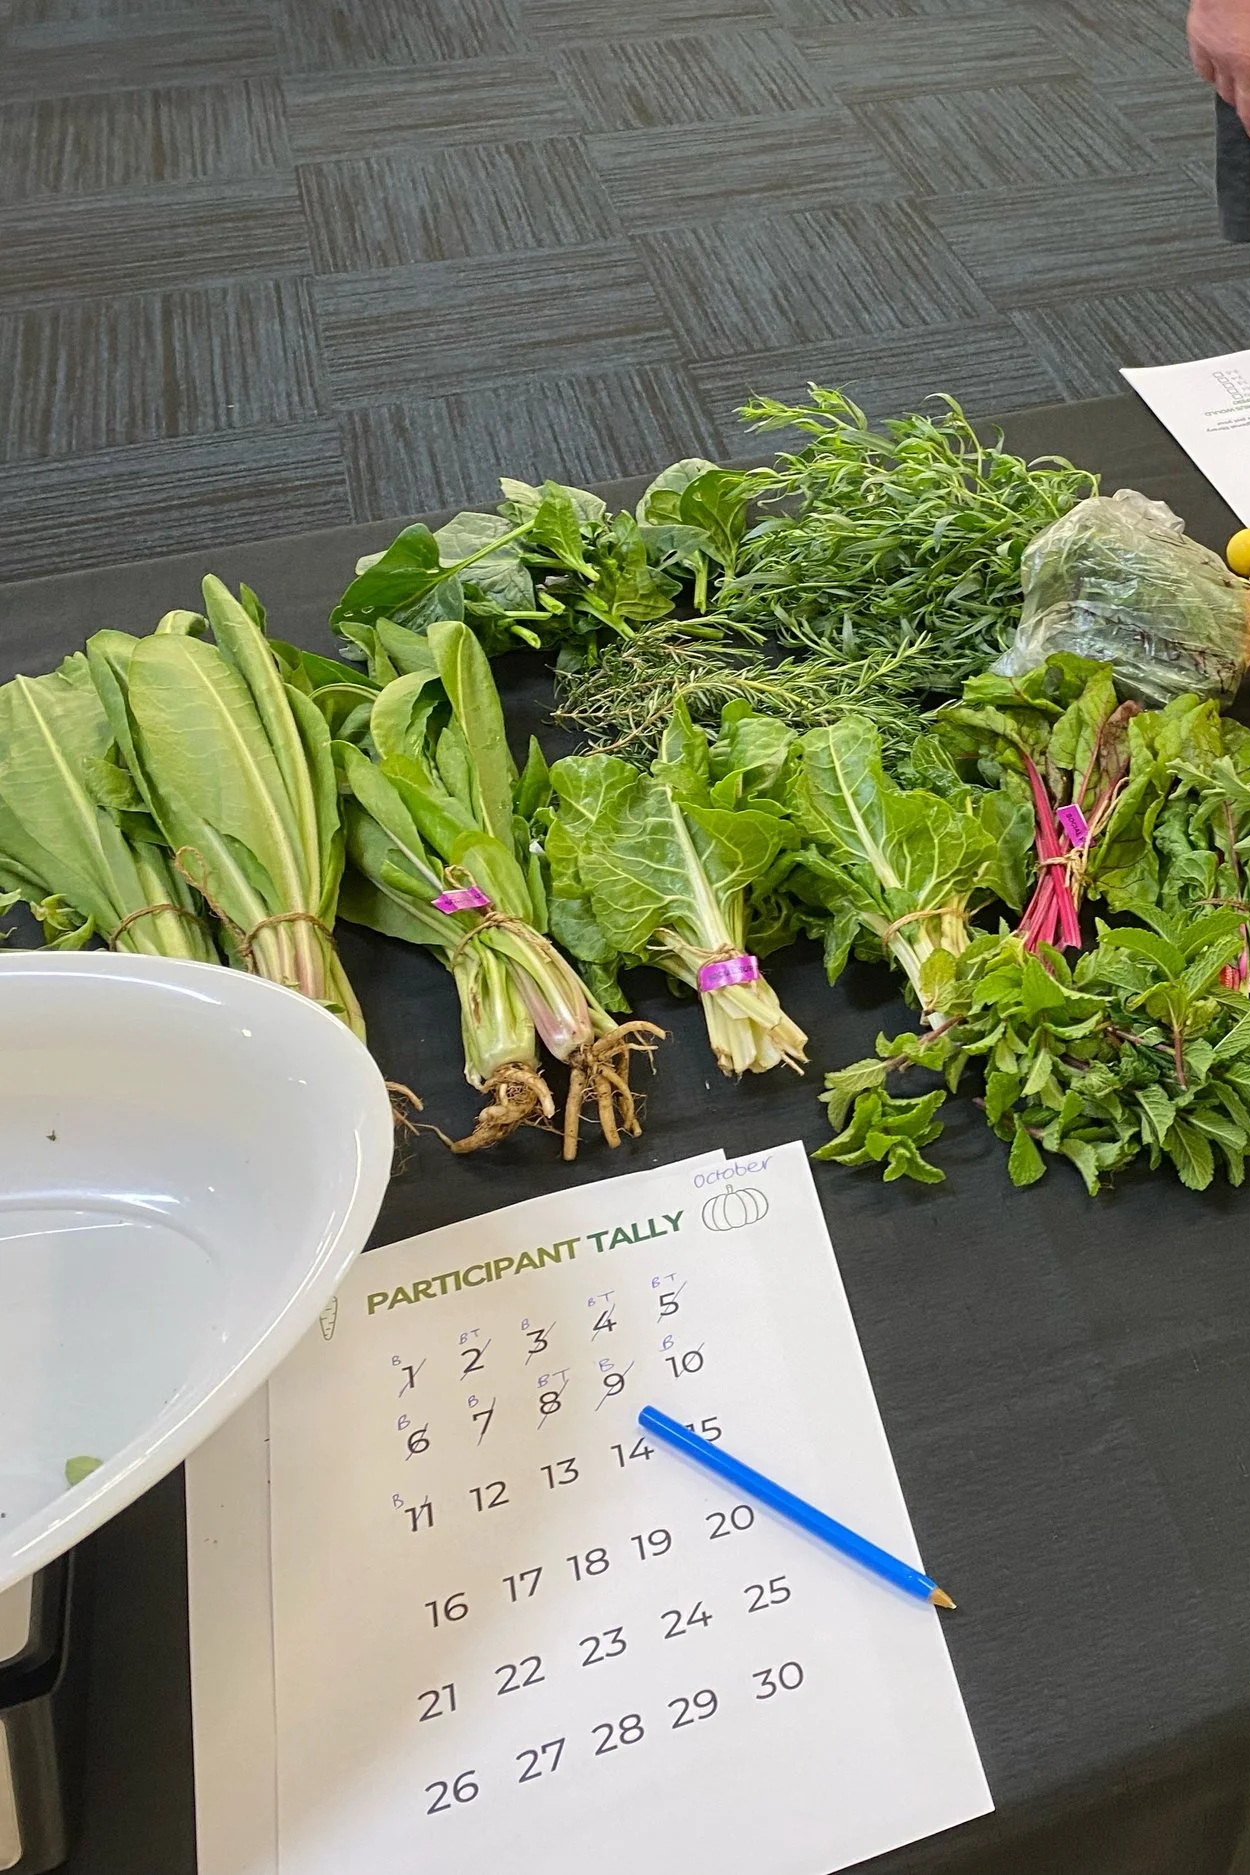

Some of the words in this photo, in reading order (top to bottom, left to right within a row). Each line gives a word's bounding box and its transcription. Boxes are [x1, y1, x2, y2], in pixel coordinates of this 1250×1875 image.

[694, 1156, 772, 1189] October
[366, 1238, 581, 1315] PARTICIPANT
[587, 1210, 684, 1253] TALLY
[665, 1350, 704, 1378] 10
[404, 1502, 434, 1532] 11
[469, 1481, 509, 1512] 12
[540, 1457, 579, 1489] 13
[610, 1436, 655, 1467] 14
[424, 1592, 469, 1627] 16
[503, 1567, 543, 1602] 17
[566, 1547, 610, 1581] 18
[631, 1529, 672, 1560] 19
[705, 1504, 754, 1540] 20
[417, 1683, 457, 1722] 21
[494, 1655, 545, 1695] 22
[579, 1626, 628, 1667] 23
[660, 1600, 713, 1639] 24
[743, 1575, 791, 1613] 25
[424, 1770, 479, 1815] 26
[516, 1738, 565, 1783] 27
[591, 1713, 645, 1755] 28
[667, 1689, 719, 1729] 29
[752, 1661, 804, 1700] 30
